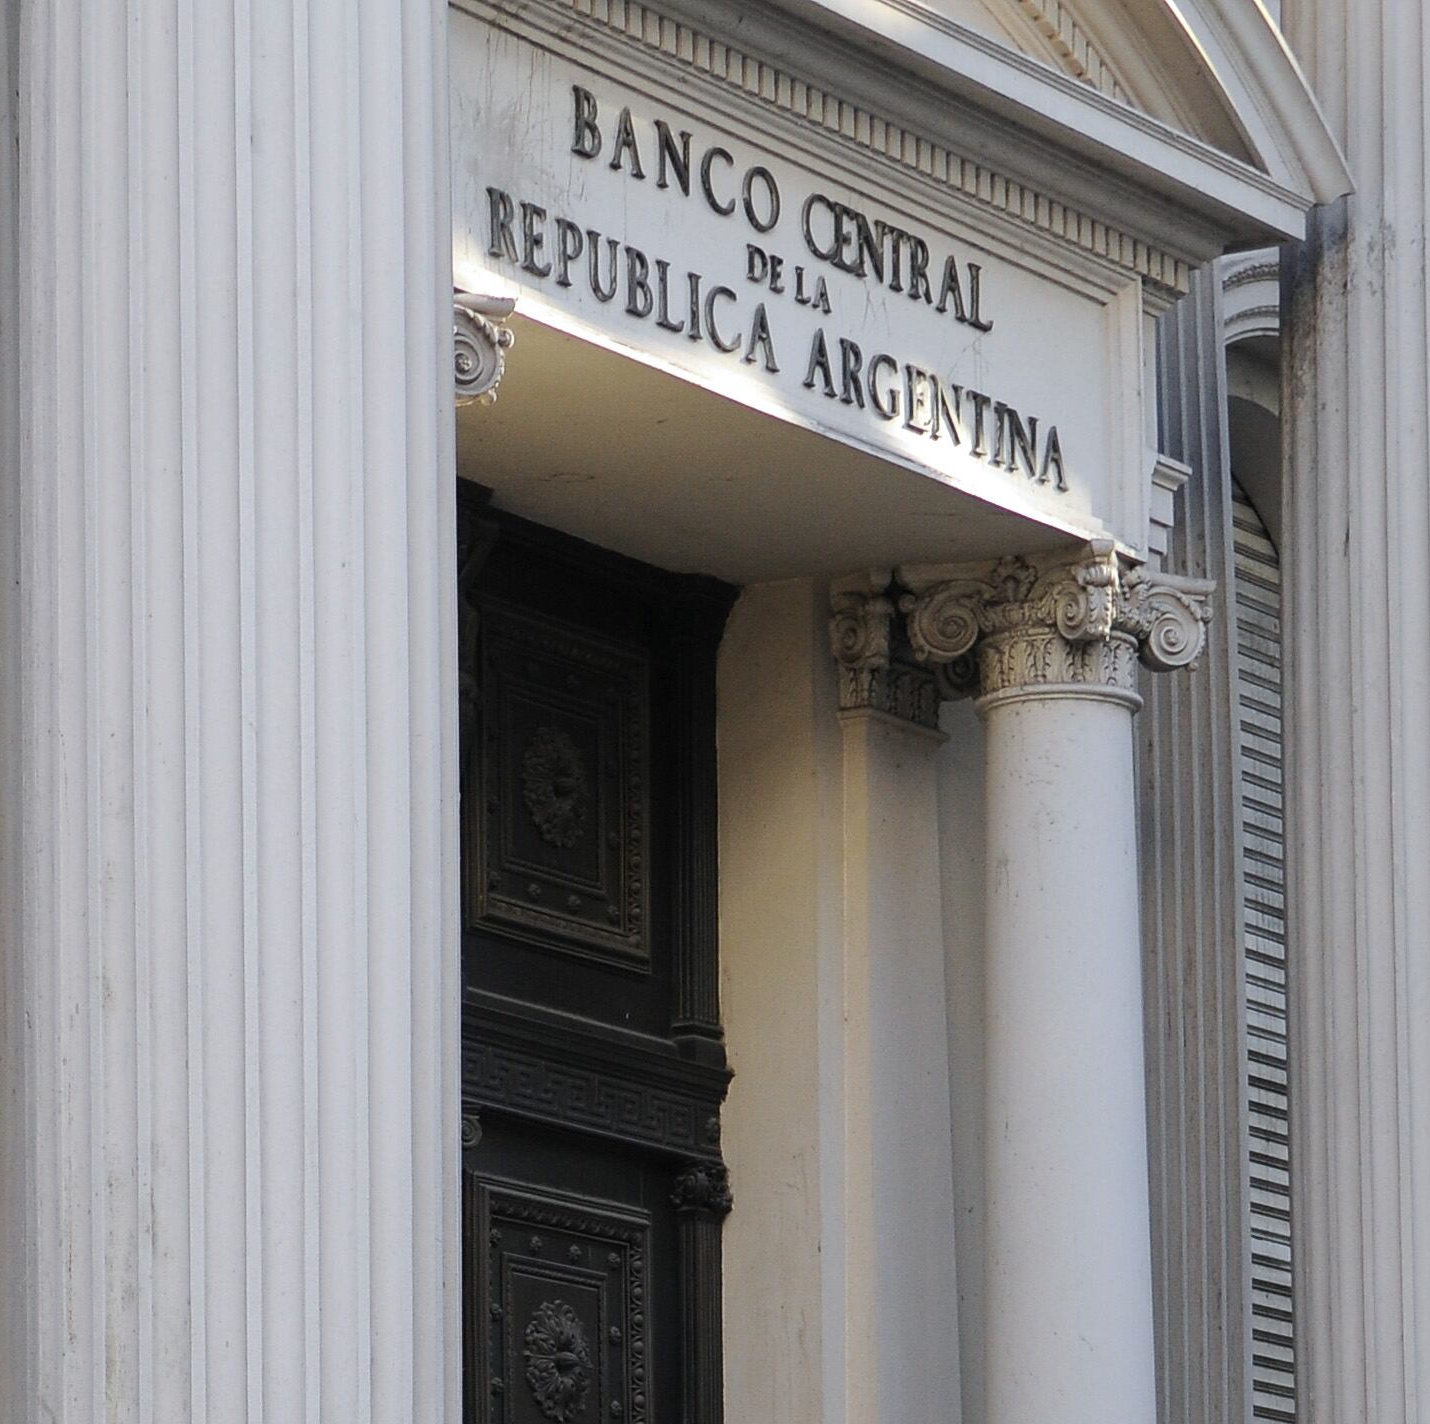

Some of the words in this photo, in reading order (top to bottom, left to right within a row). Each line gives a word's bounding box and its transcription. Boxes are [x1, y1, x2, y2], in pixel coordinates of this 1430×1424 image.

[572, 85, 780, 232] BANCO
[803, 193, 993, 331] CENTRAL
[746, 243, 784, 293] DE
[794, 265, 832, 314] LA
[487, 186, 779, 372] REPUBLICA
[803, 327, 1069, 492] ARGENTINA
